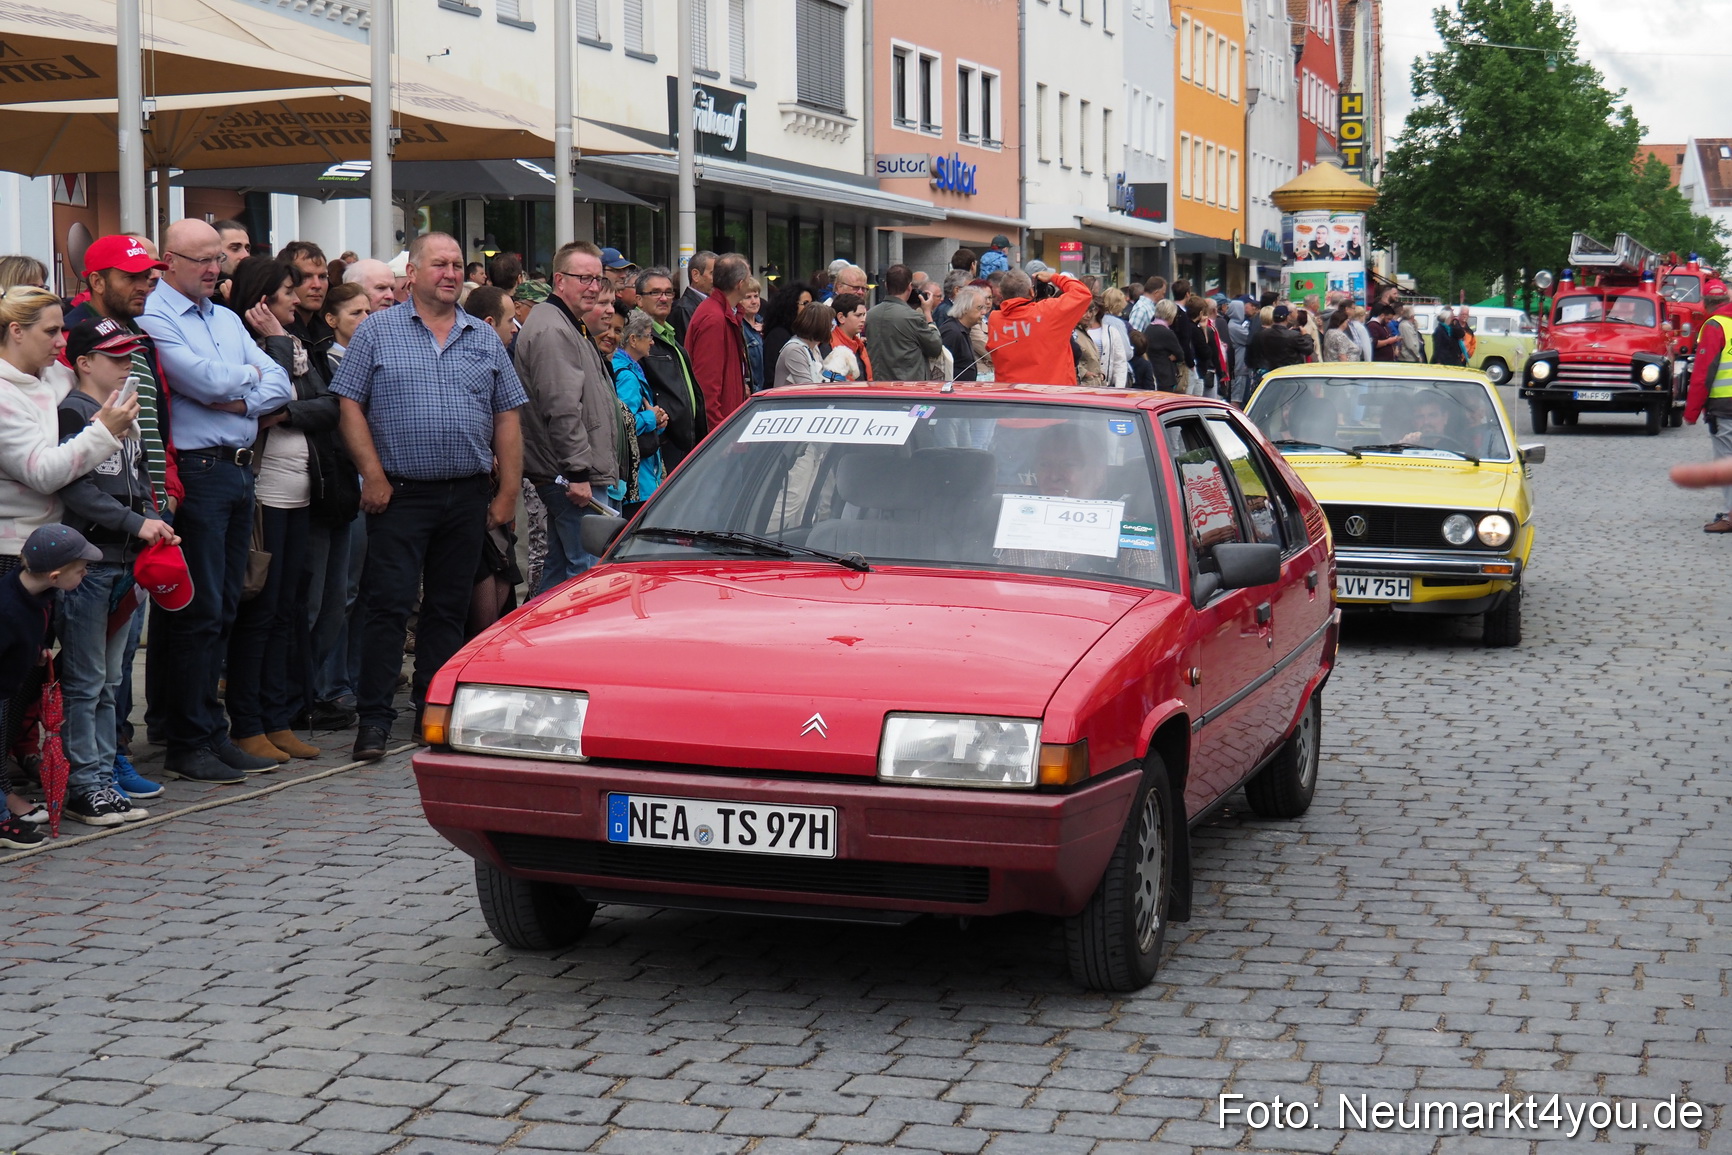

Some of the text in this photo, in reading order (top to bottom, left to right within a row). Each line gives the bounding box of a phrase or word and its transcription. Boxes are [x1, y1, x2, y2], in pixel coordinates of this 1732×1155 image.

[751, 416, 899, 437] 600 000 km
[1058, 510, 1098, 524] 403
[1344, 577, 1410, 597] VW 75H
[614, 823, 623, 833] D
[629, 801, 829, 851] NEA TS 97H
